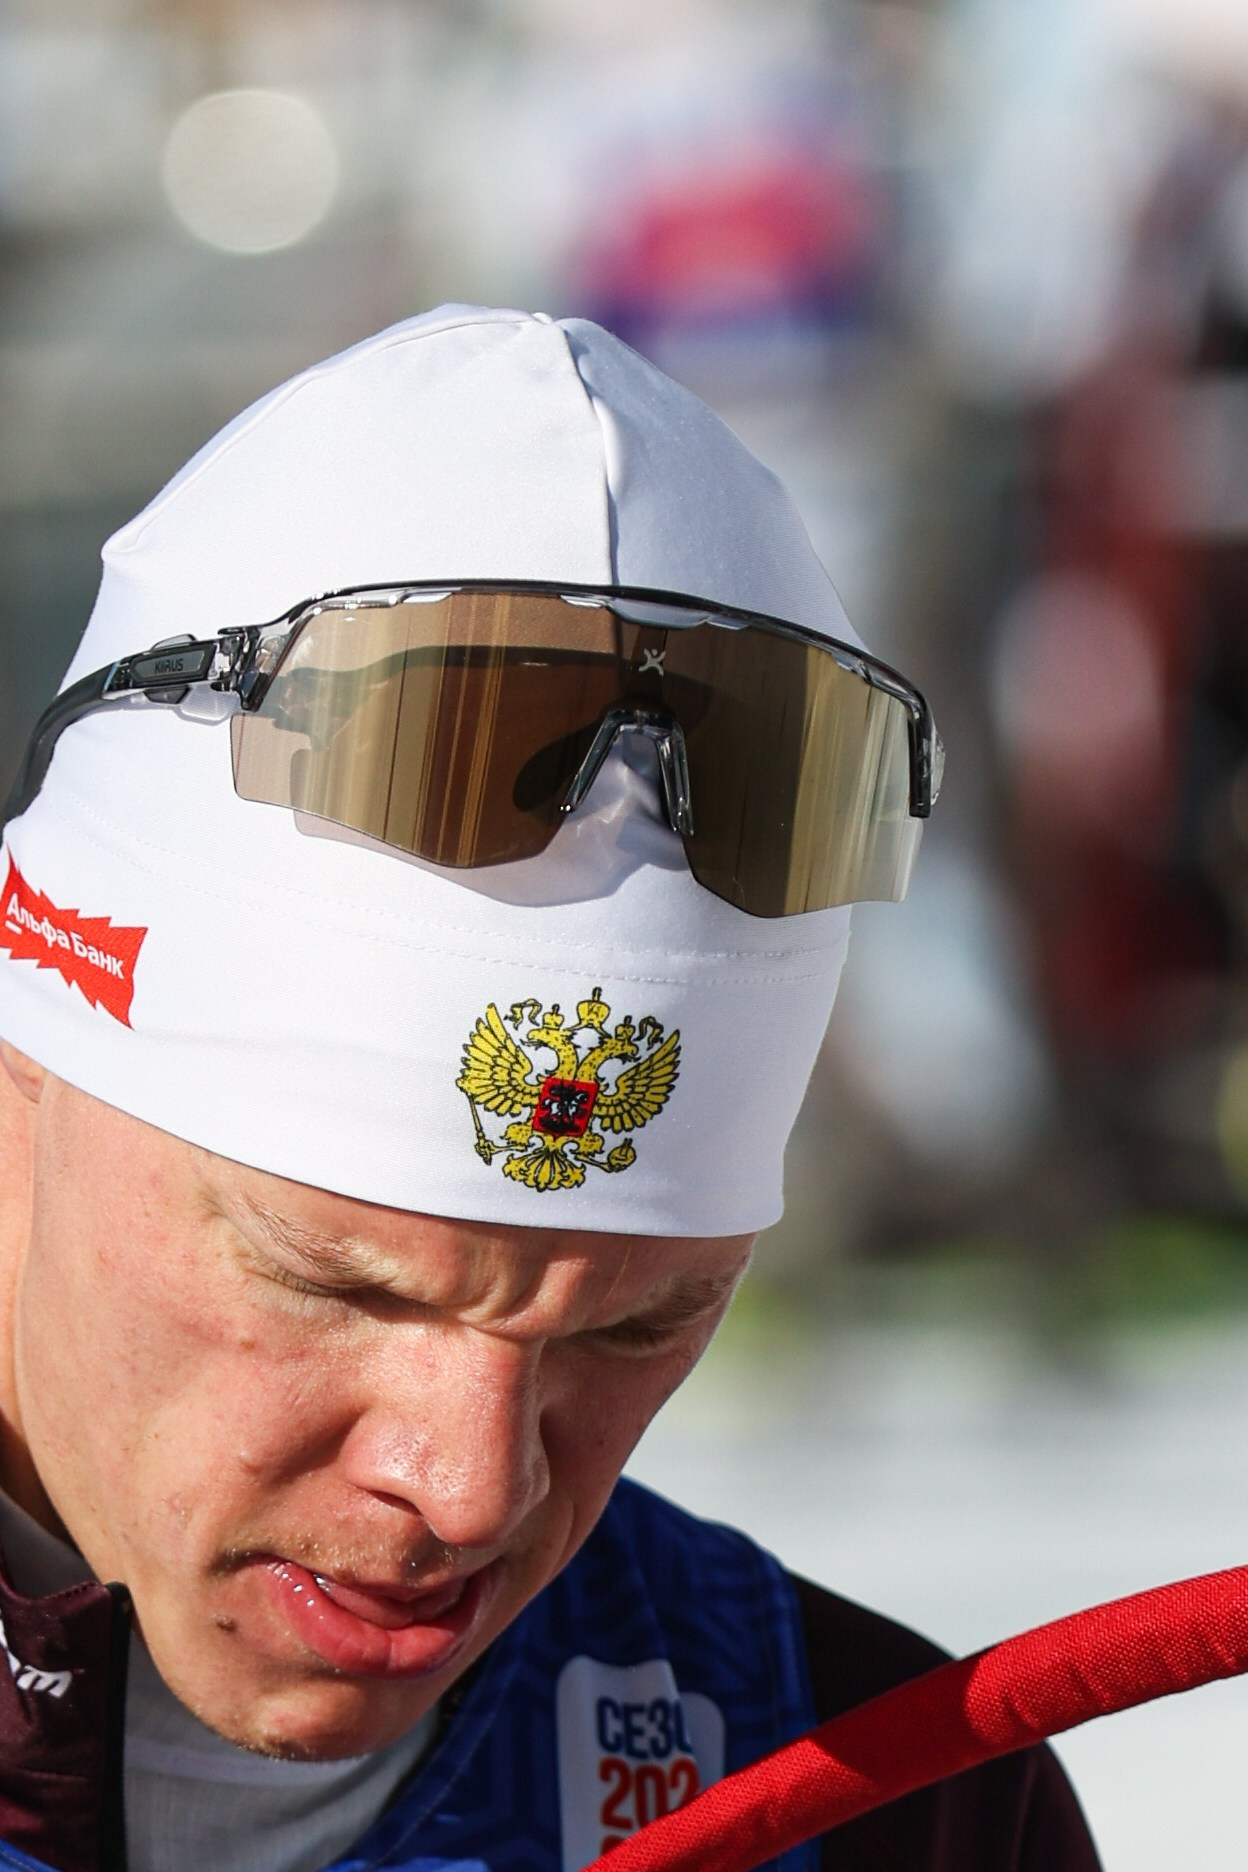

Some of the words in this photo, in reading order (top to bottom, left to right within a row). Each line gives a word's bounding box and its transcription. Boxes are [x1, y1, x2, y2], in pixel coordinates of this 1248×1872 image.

[5, 893, 71, 949] Альфа
[69, 931, 125, 980] Банк
[599, 1757, 701, 1830] 202
